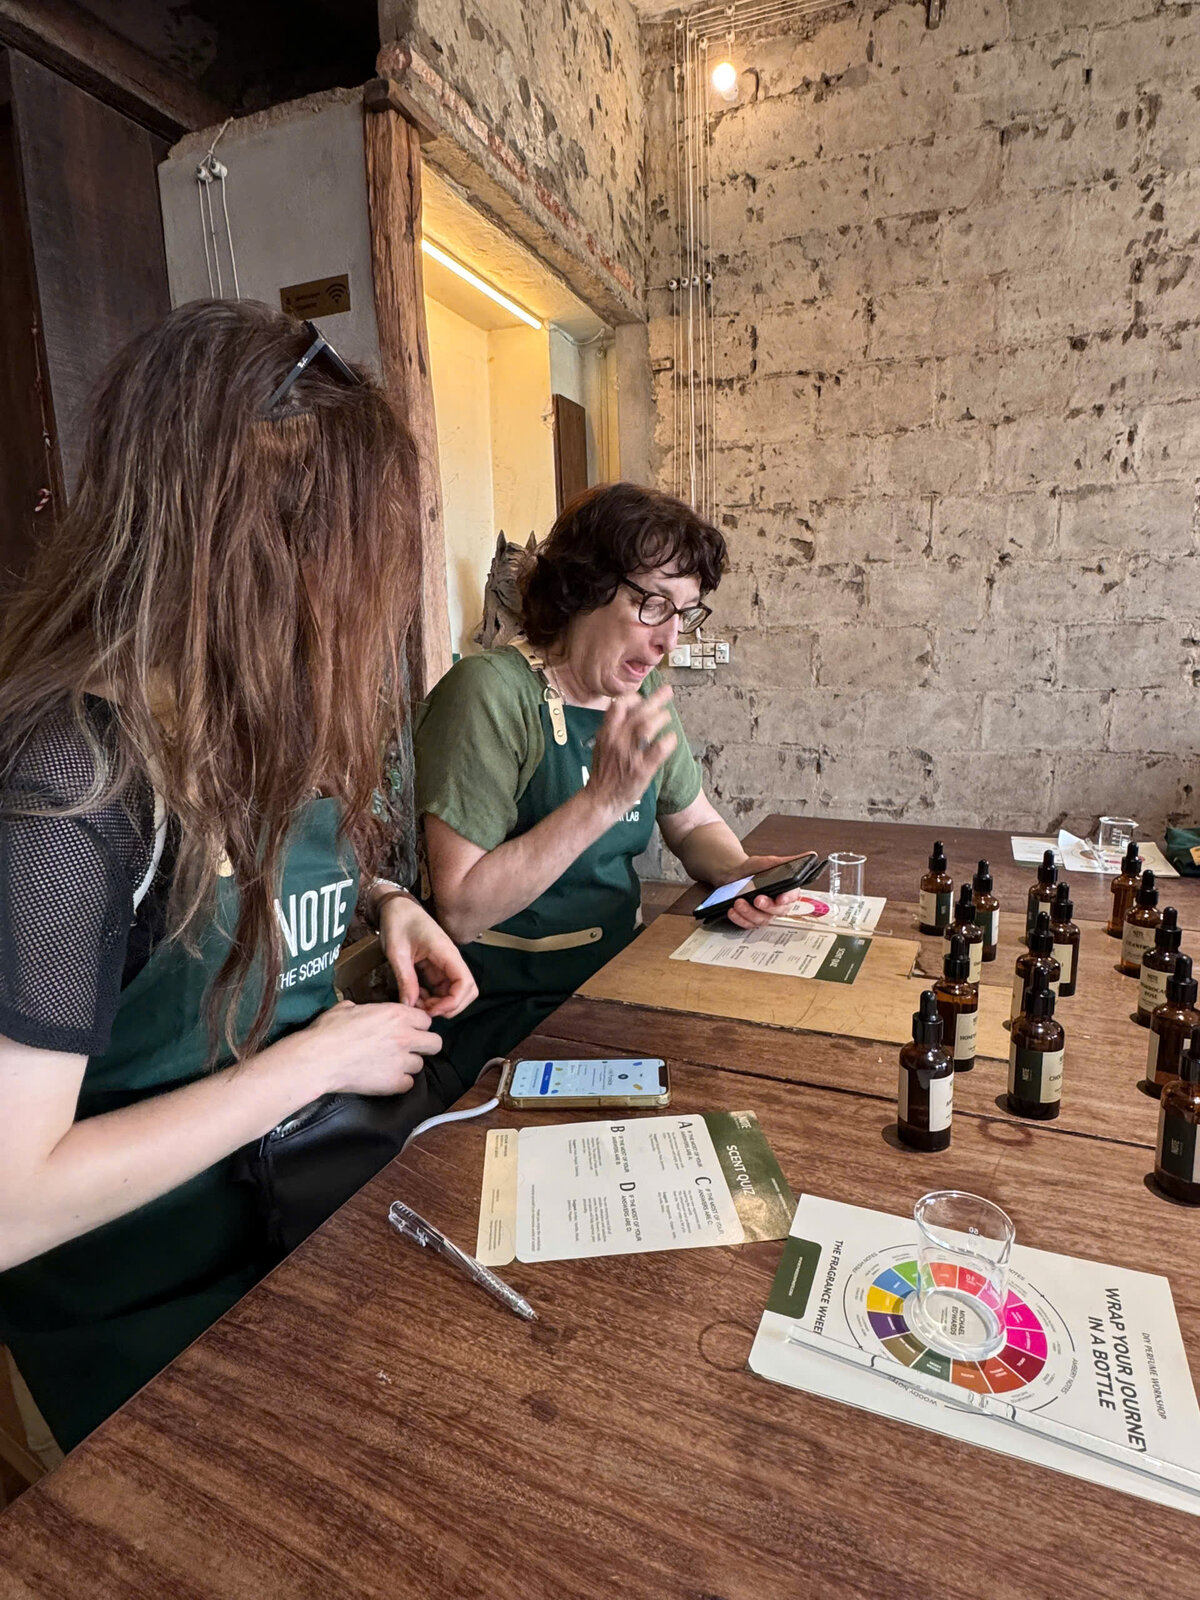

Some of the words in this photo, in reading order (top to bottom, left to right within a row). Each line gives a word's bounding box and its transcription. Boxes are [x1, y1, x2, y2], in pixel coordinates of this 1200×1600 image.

[626, 811, 640, 822] LAB
[274, 879, 354, 958] NOTE
[299, 952, 330, 981] SCENT
[330, 944, 340, 966] LAB
[678, 1121, 693, 1129] A
[619, 1182, 636, 1191] D
[694, 1176, 712, 1186] C
[726, 1144, 746, 1173] SCENT
[738, 1173, 756, 1196] QUIZ
[832, 1240, 844, 1256] THE
[821, 1256, 839, 1304] FRAGRANCE
[1088, 1316, 1104, 1332] IN
[1105, 1288, 1126, 1332] WRAP
[1090, 1334, 1106, 1346] A
[1112, 1335, 1133, 1376] YOUR
[1144, 1343, 1158, 1376] PERFUME
[1093, 1349, 1116, 1411] BOTTLE
[910, 1390, 938, 1406] WOODY
[1150, 1376, 1167, 1420] WORKSHOP
